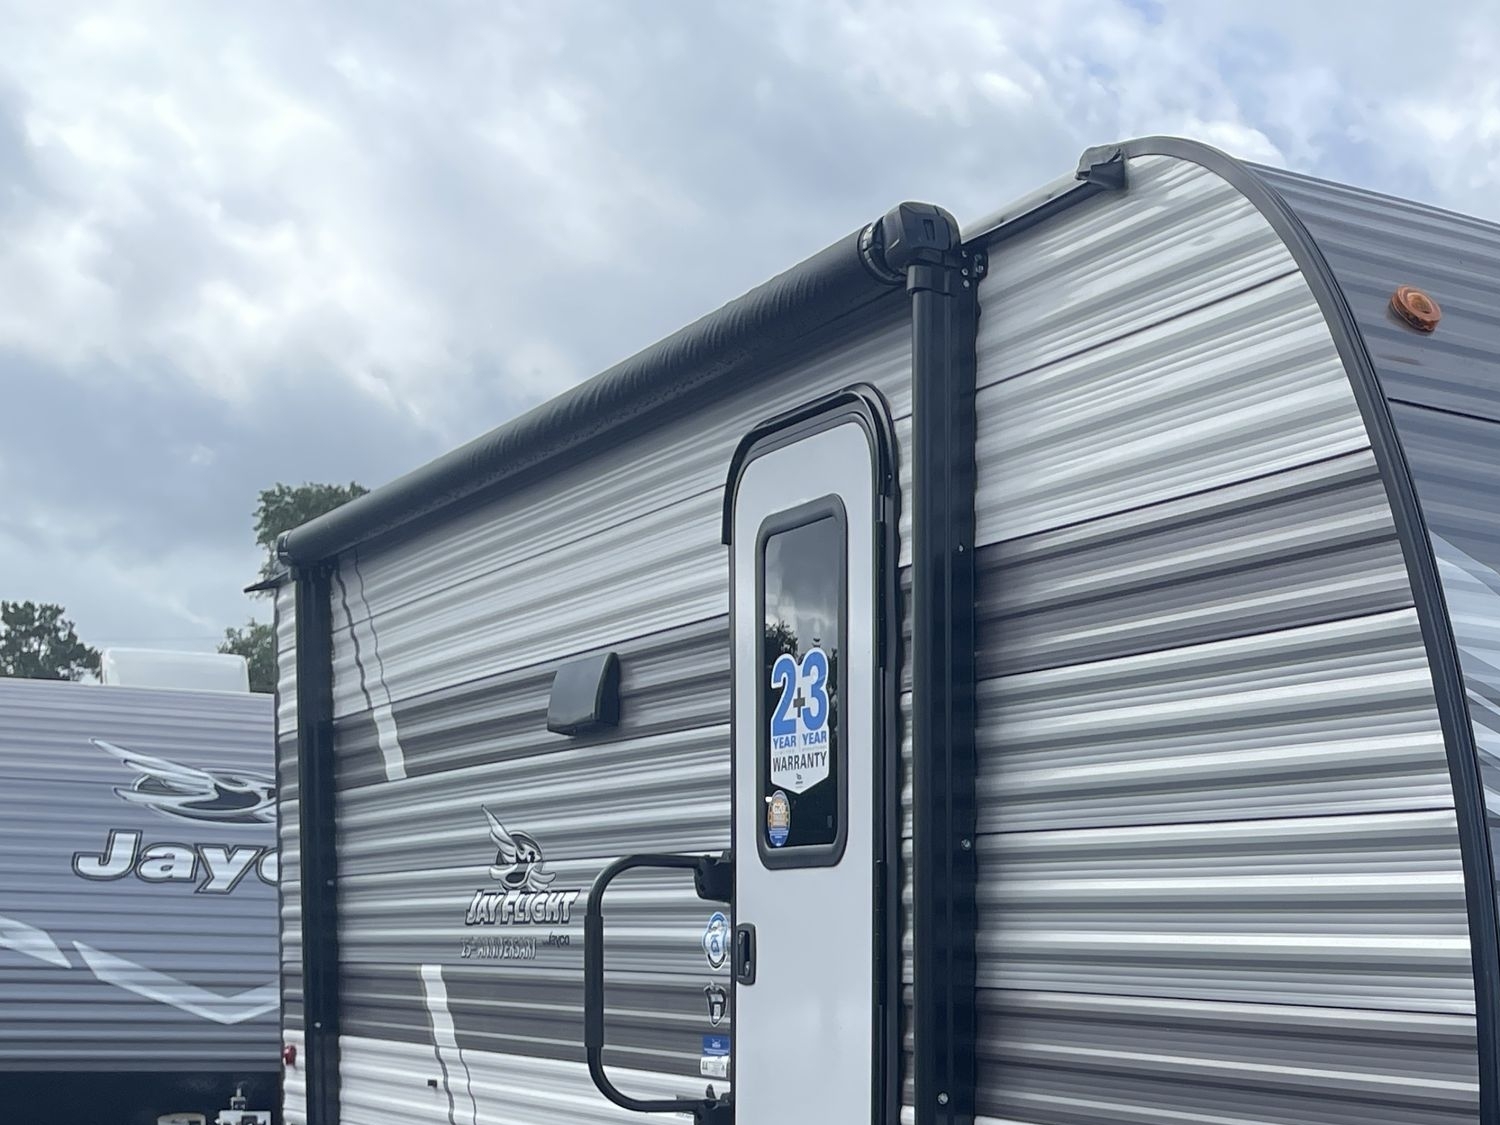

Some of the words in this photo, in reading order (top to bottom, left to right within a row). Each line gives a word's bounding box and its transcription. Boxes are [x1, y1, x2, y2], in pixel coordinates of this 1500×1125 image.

[773, 735, 796, 749] YEAR
[802, 731, 827, 745] YEAR
[772, 750, 828, 772] WARRANTY
[465, 889, 503, 925] JAY
[500, 889, 581, 925] FLIGHT
[548, 931, 570, 948] Jayco
